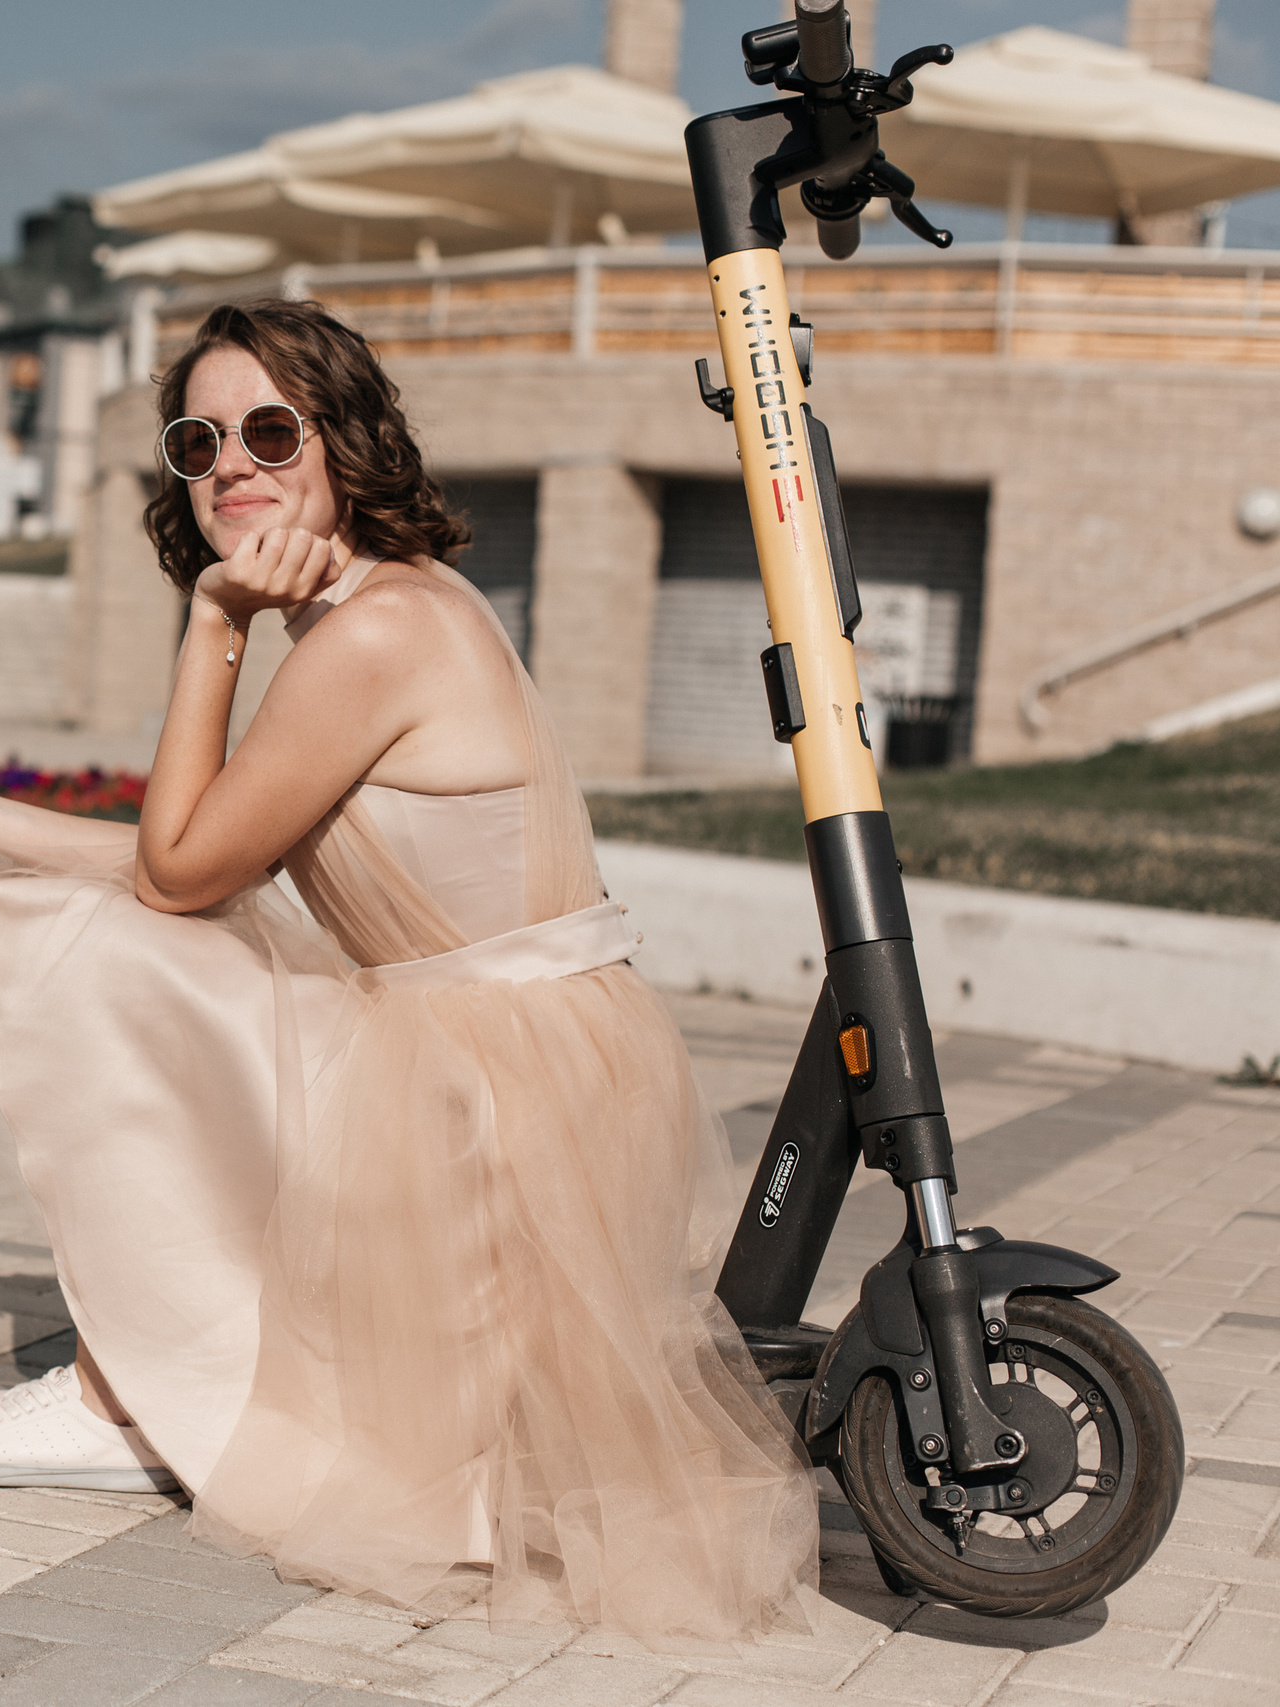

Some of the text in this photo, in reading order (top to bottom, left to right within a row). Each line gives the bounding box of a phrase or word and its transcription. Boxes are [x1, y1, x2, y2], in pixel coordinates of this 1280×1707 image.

[739, 284, 798, 470] WHOOSH
[770, 1149, 790, 1198] POWERED BY
[774, 1152, 795, 1202] SEGWAY
